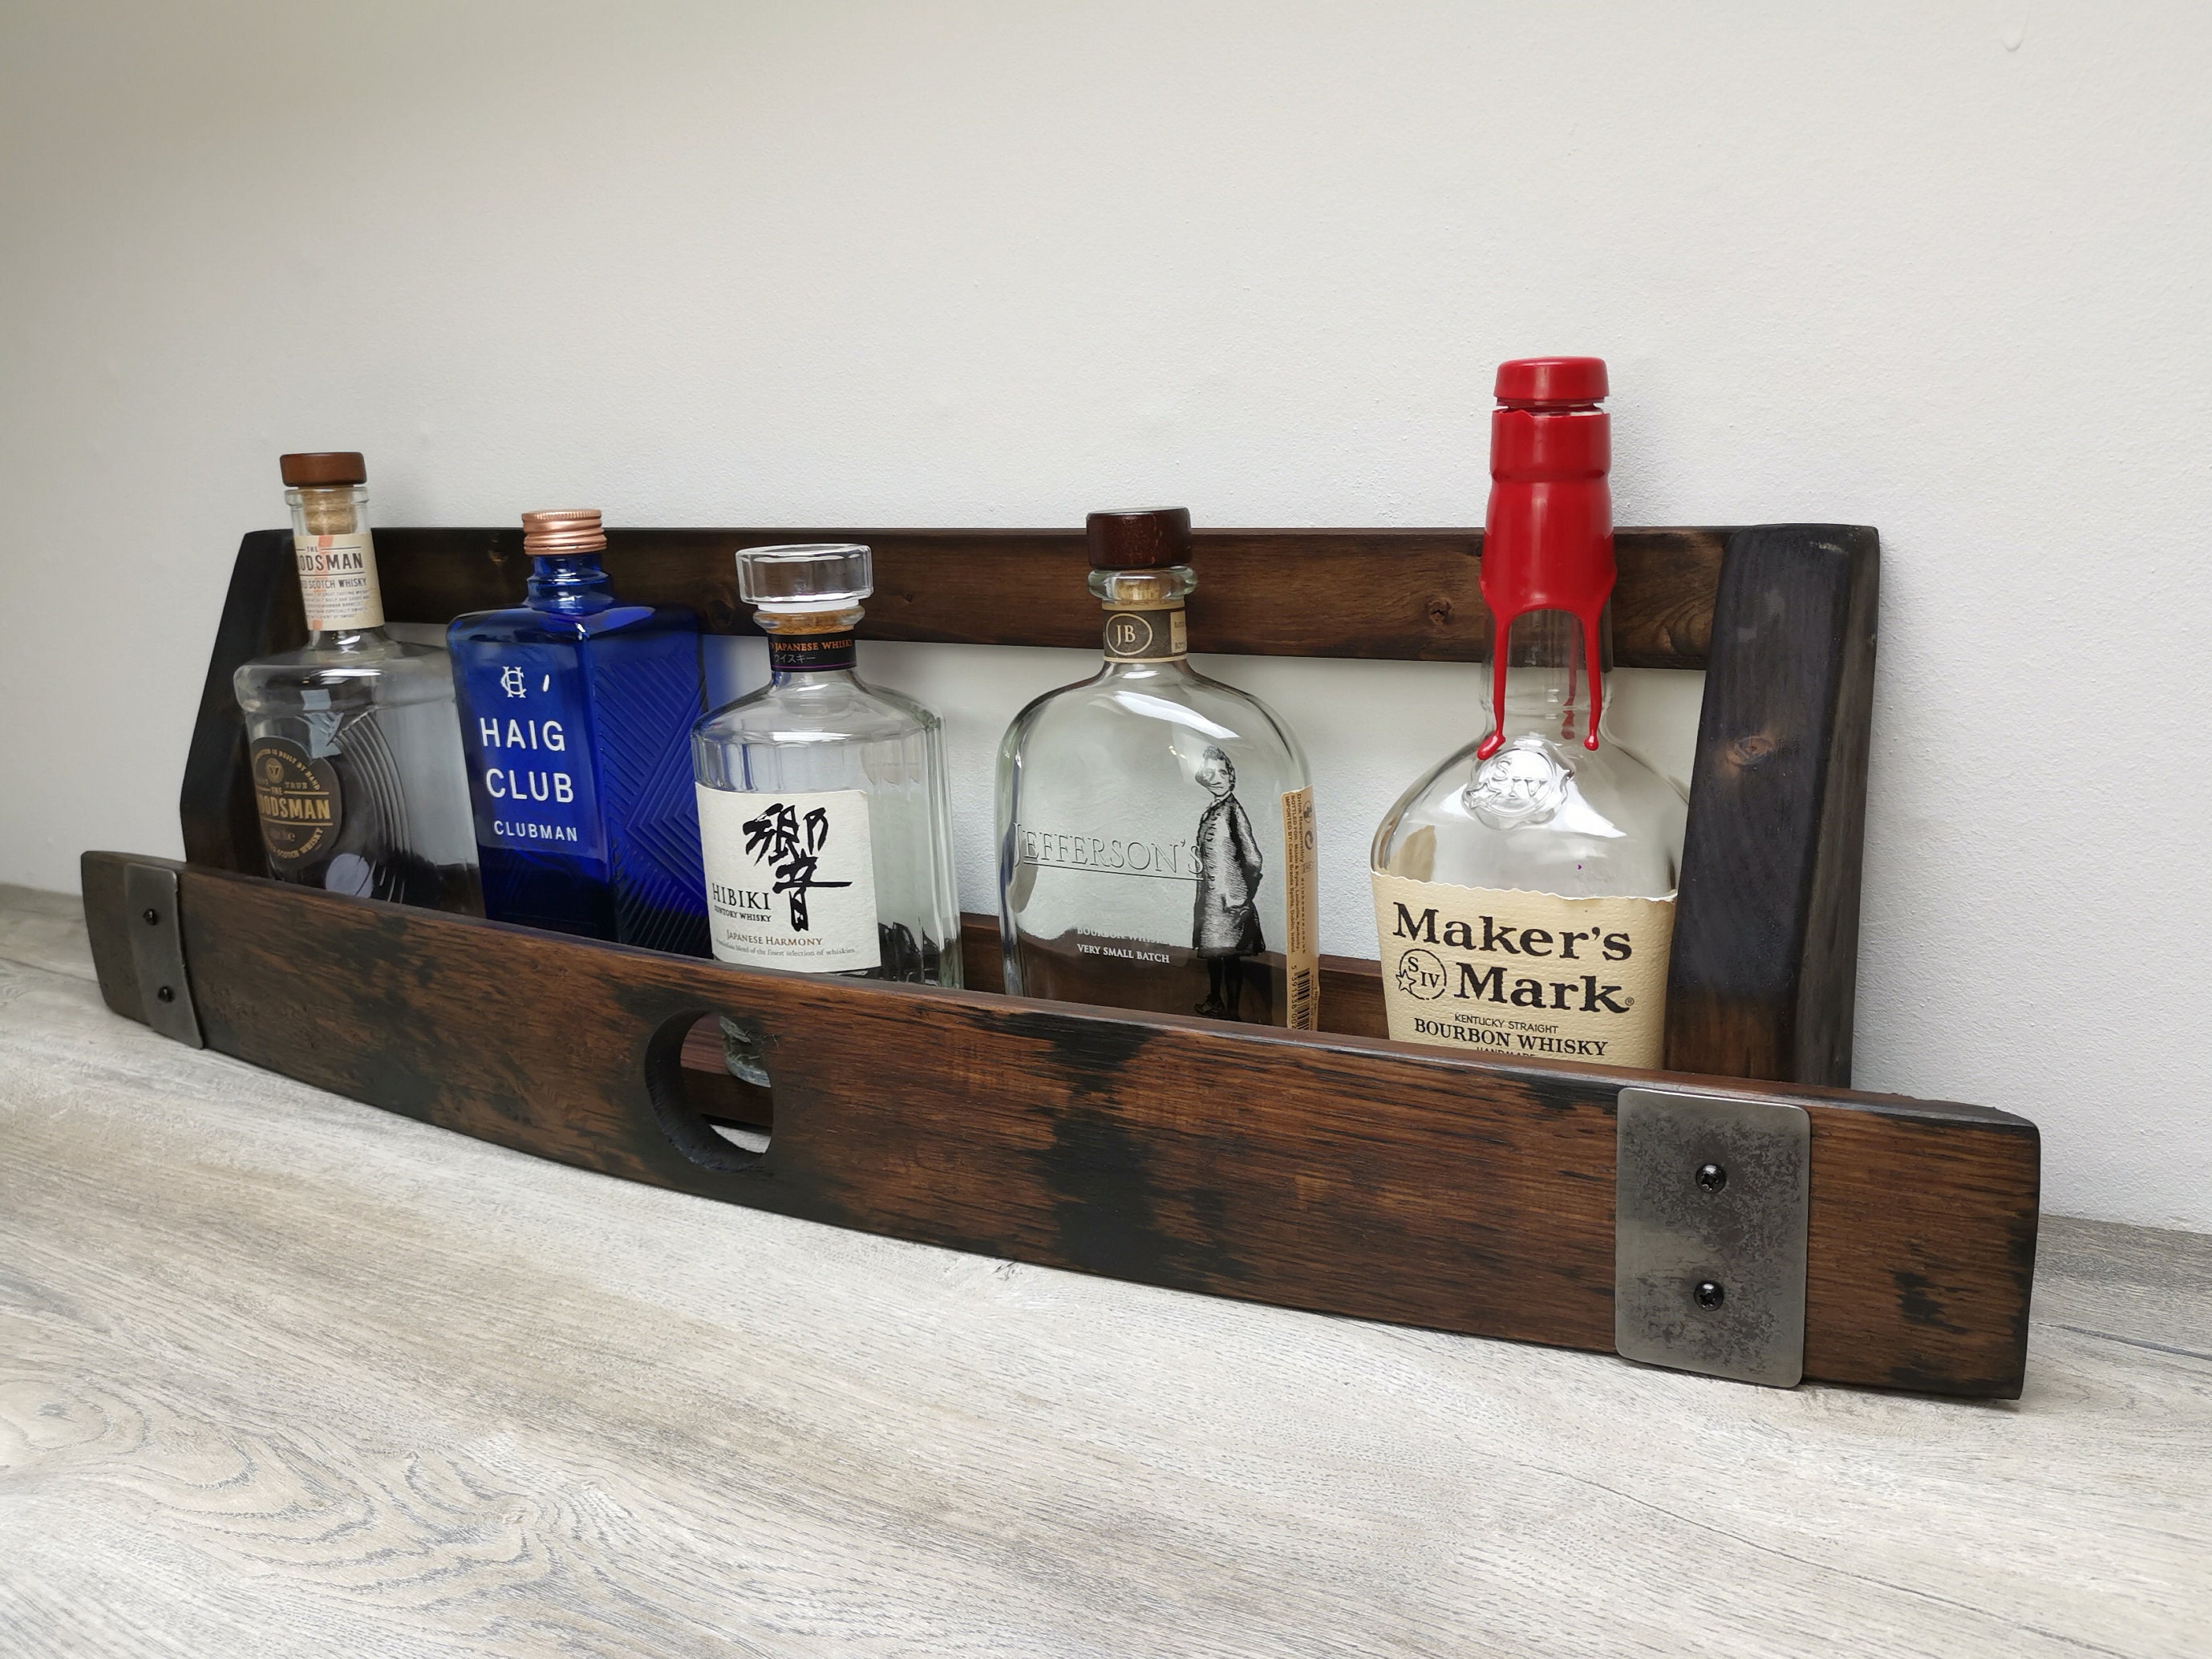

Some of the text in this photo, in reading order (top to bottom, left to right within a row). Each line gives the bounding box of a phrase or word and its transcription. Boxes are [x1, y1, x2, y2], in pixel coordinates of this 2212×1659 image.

[296, 553, 364, 571] ODSMAN
[308, 578, 336, 590] SCOTCH
[338, 577, 367, 588] WHISKY
[775, 642, 819, 652] JAPANESE
[1116, 624, 1136, 648] JB
[480, 717, 565, 752] HAIG
[486, 768, 574, 803] CLUB
[257, 793, 331, 820] OODSMAN
[493, 820, 577, 842] CLUBMAN
[1013, 822, 1204, 874] JEFFERSON'S
[711, 882, 772, 911] HIBIKI
[714, 904, 772, 923] SUNTORY WHISKY
[727, 929, 763, 945] JAPANESE
[765, 936, 823, 947] HARMONY
[1392, 901, 1633, 961] Maker's
[816, 948, 824, 956] of
[825, 947, 856, 955] whiskies
[1076, 943, 1171, 963] VERY SMALL BATCH
[1453, 962, 1631, 1014] Mark
[1454, 1012, 1559, 1035] KENTUCKY STRAIGHT
[1414, 1017, 1609, 1057] BOURBON WHISKY
